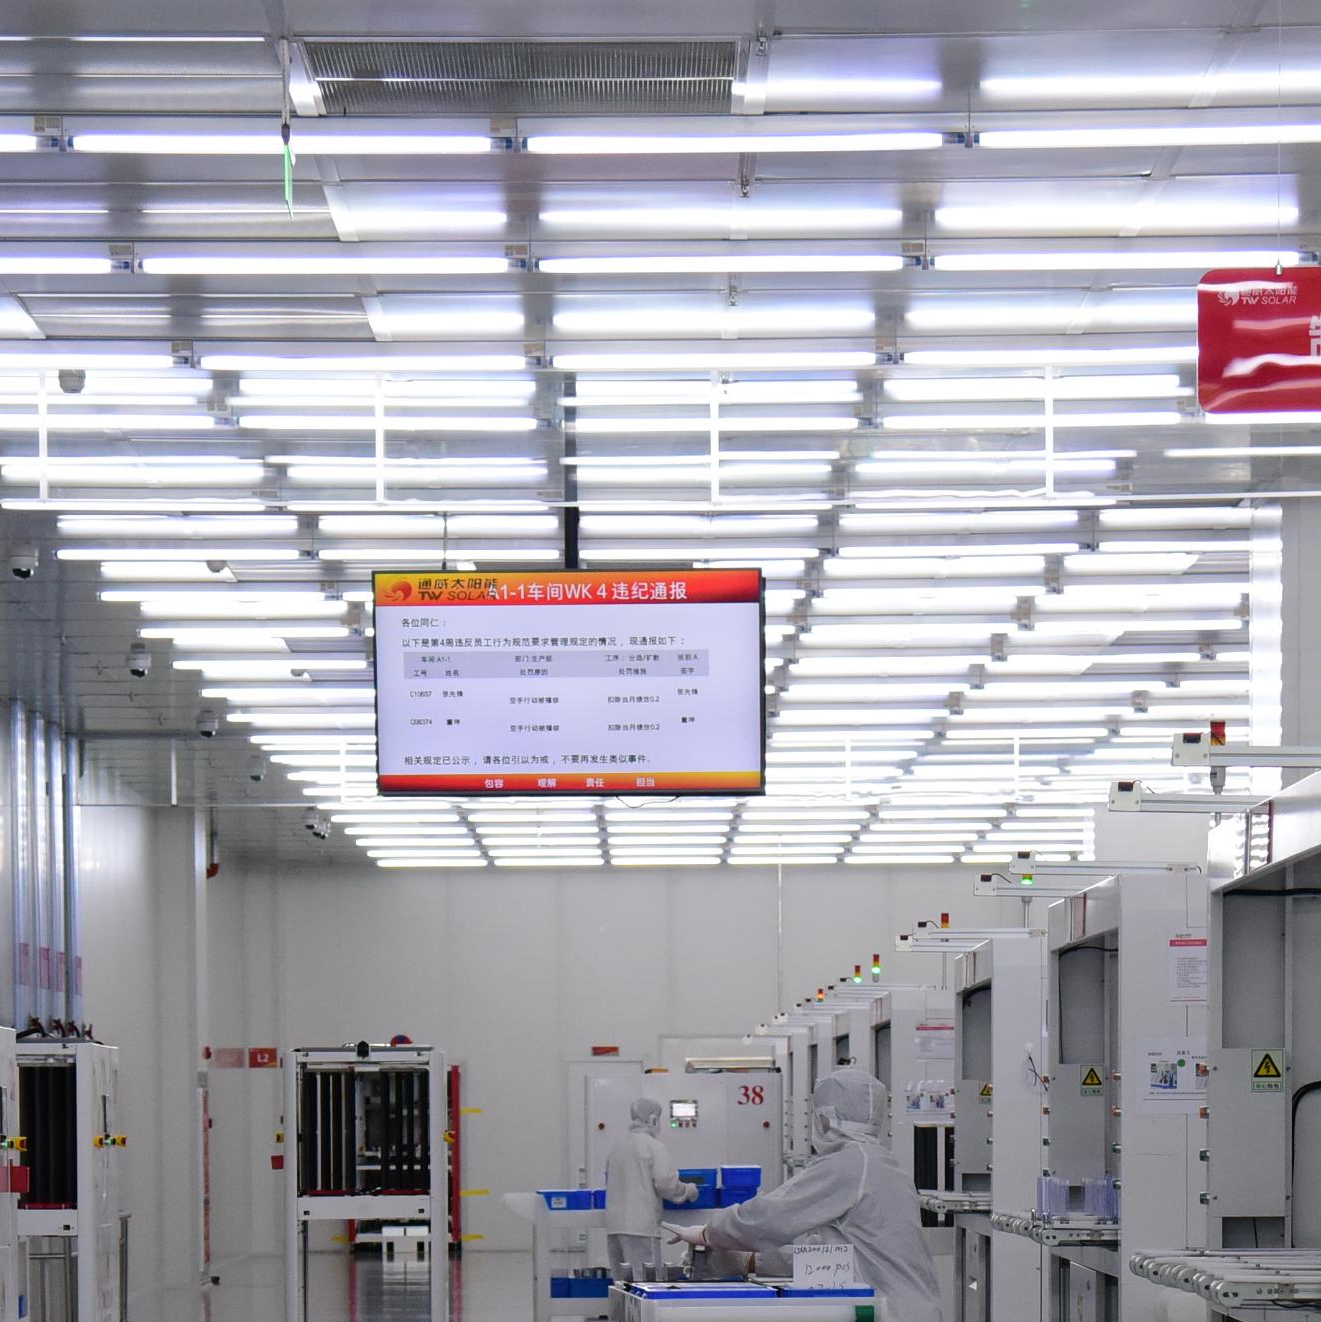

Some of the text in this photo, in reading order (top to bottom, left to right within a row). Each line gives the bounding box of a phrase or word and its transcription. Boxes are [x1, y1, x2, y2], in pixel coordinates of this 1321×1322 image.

[1240, 295, 1297, 305] TW SOLAR
[418, 577, 499, 590] 通威太阳能
[418, 590, 444, 601] TW
[596, 583, 607, 599] 4
[611, 581, 688, 600] 违纪通报
[484, 779, 504, 789] 包容
[537, 778, 557, 788] 理解
[585, 777, 605, 788] 责任
[635, 776, 655, 787] 担当
[256, 1053, 270, 1063] L2
[737, 1085, 765, 1106] 38
